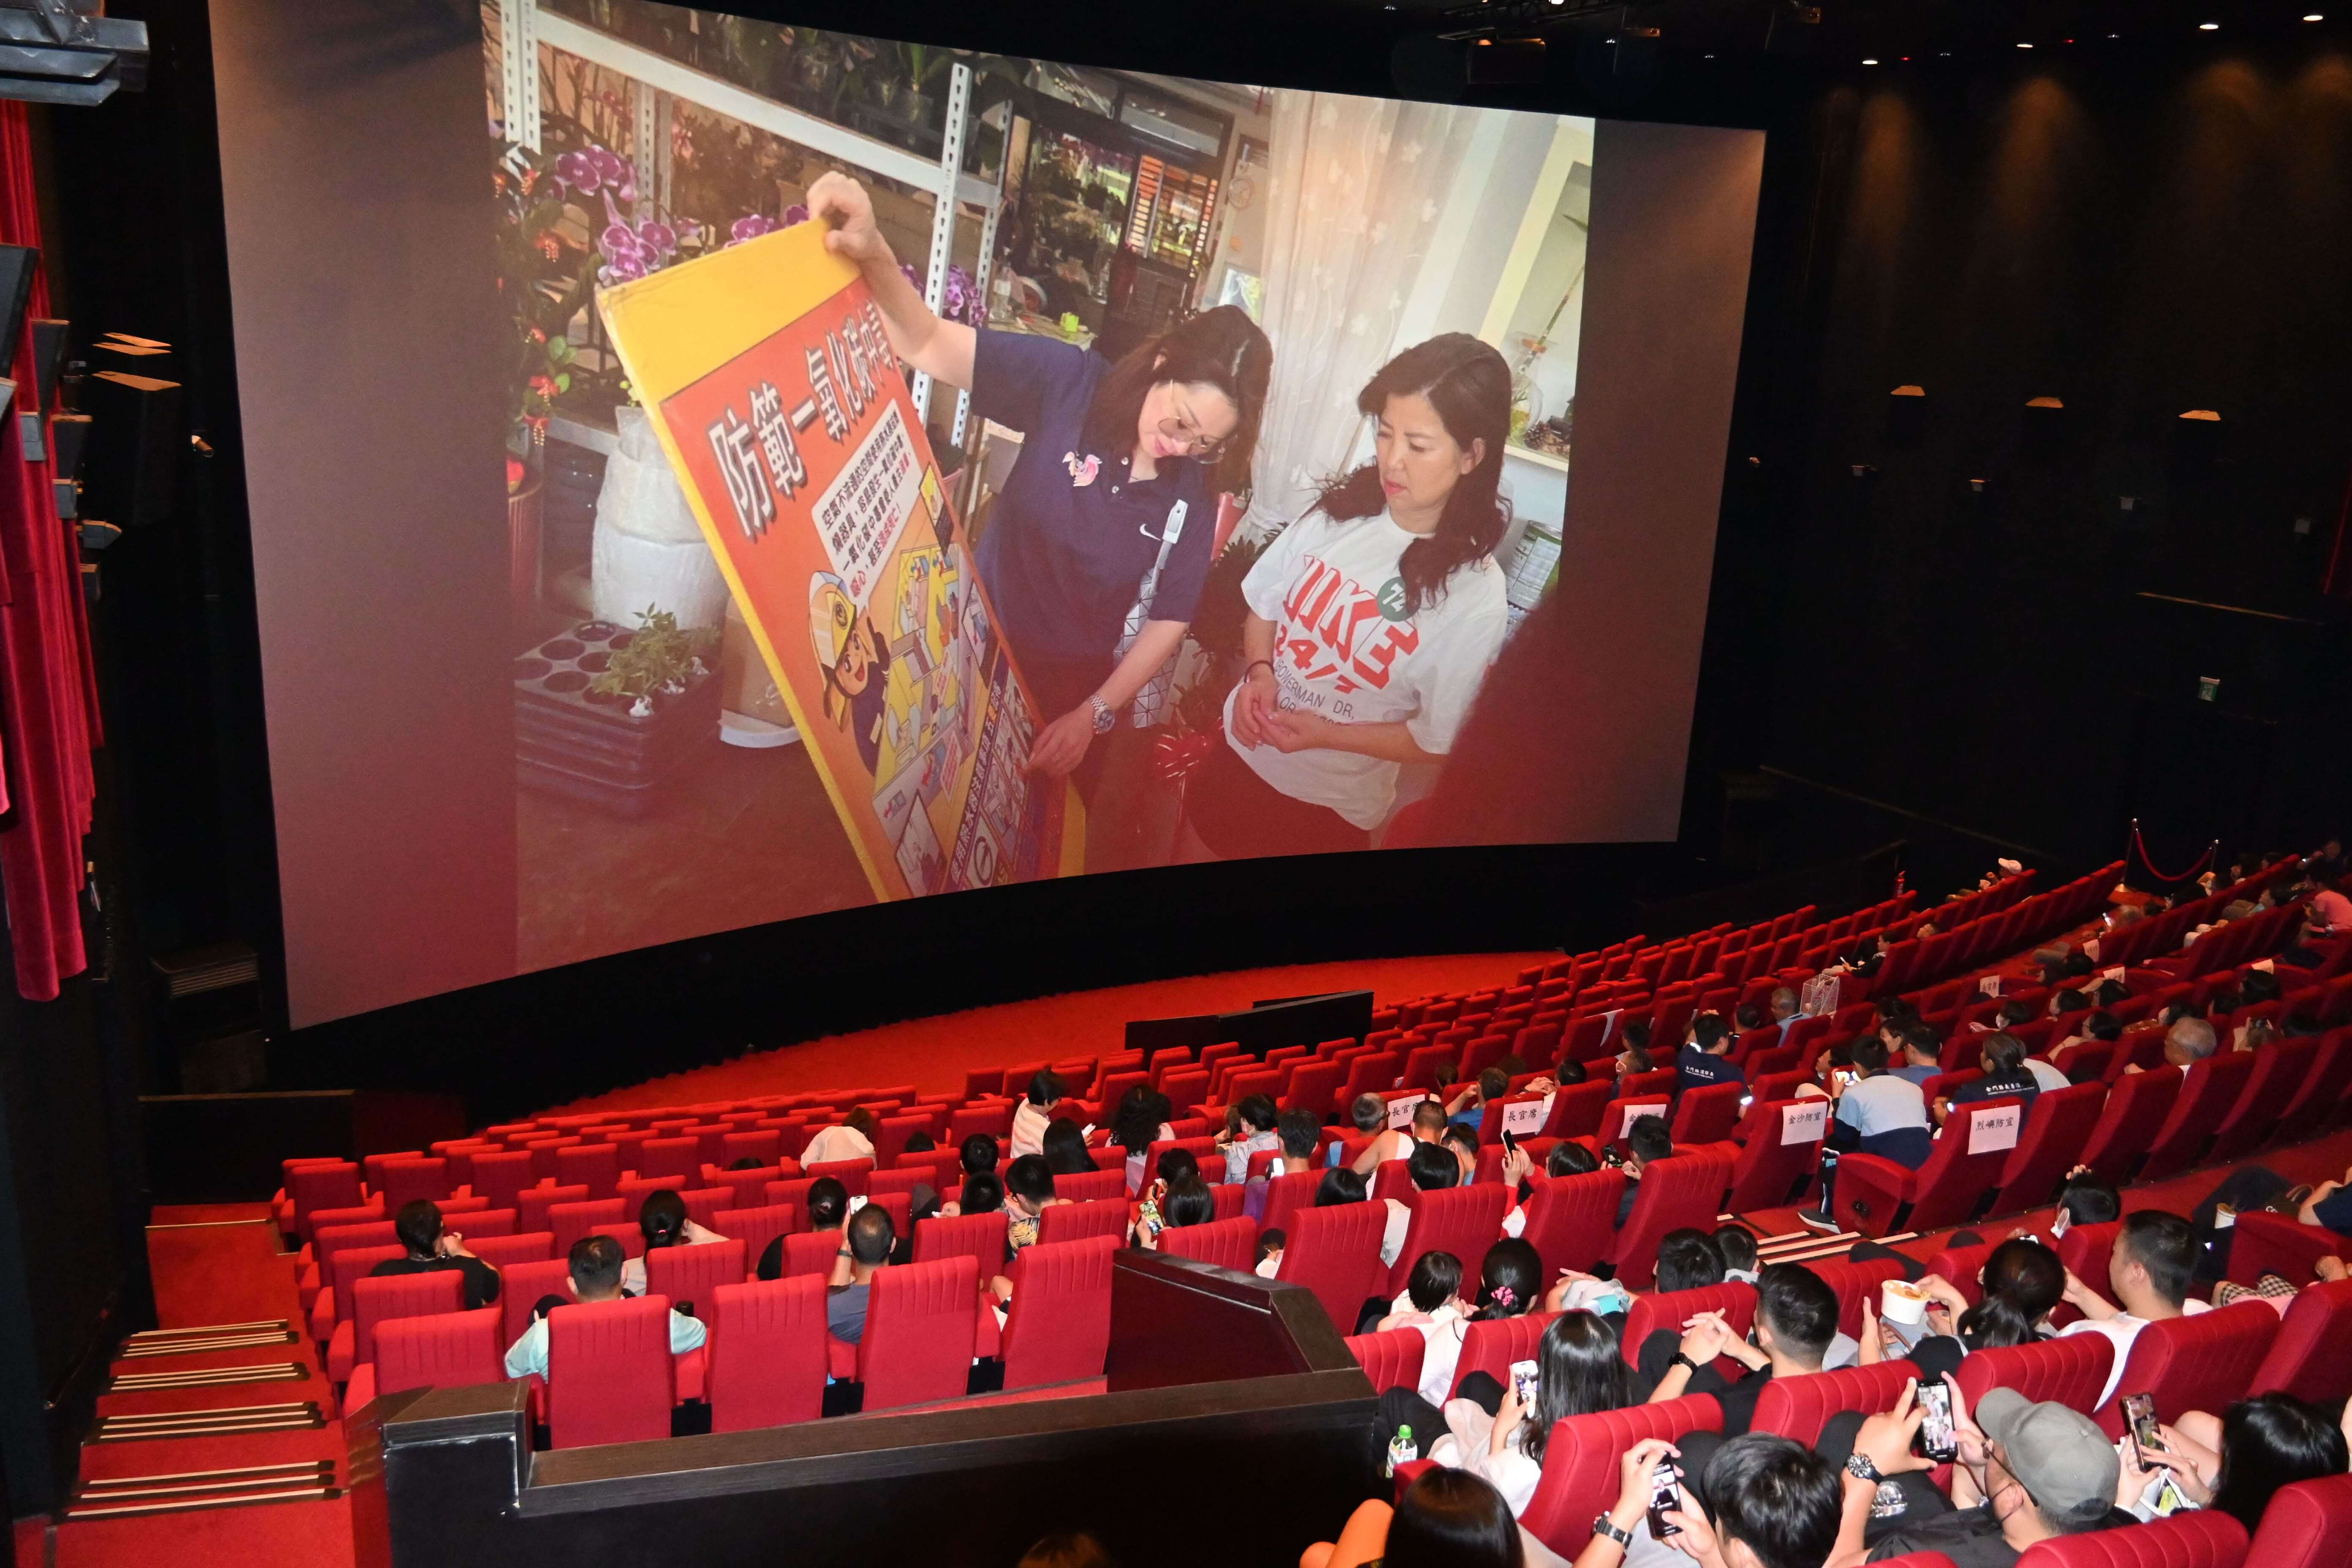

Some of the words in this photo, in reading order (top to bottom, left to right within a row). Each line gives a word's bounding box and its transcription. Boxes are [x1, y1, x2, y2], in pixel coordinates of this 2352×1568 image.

[708, 301, 893, 538] 防範一氧化碳中毒
[1507, 1108, 1538, 1122] 長官席
[1788, 1111, 1821, 1125] 金沙防宣
